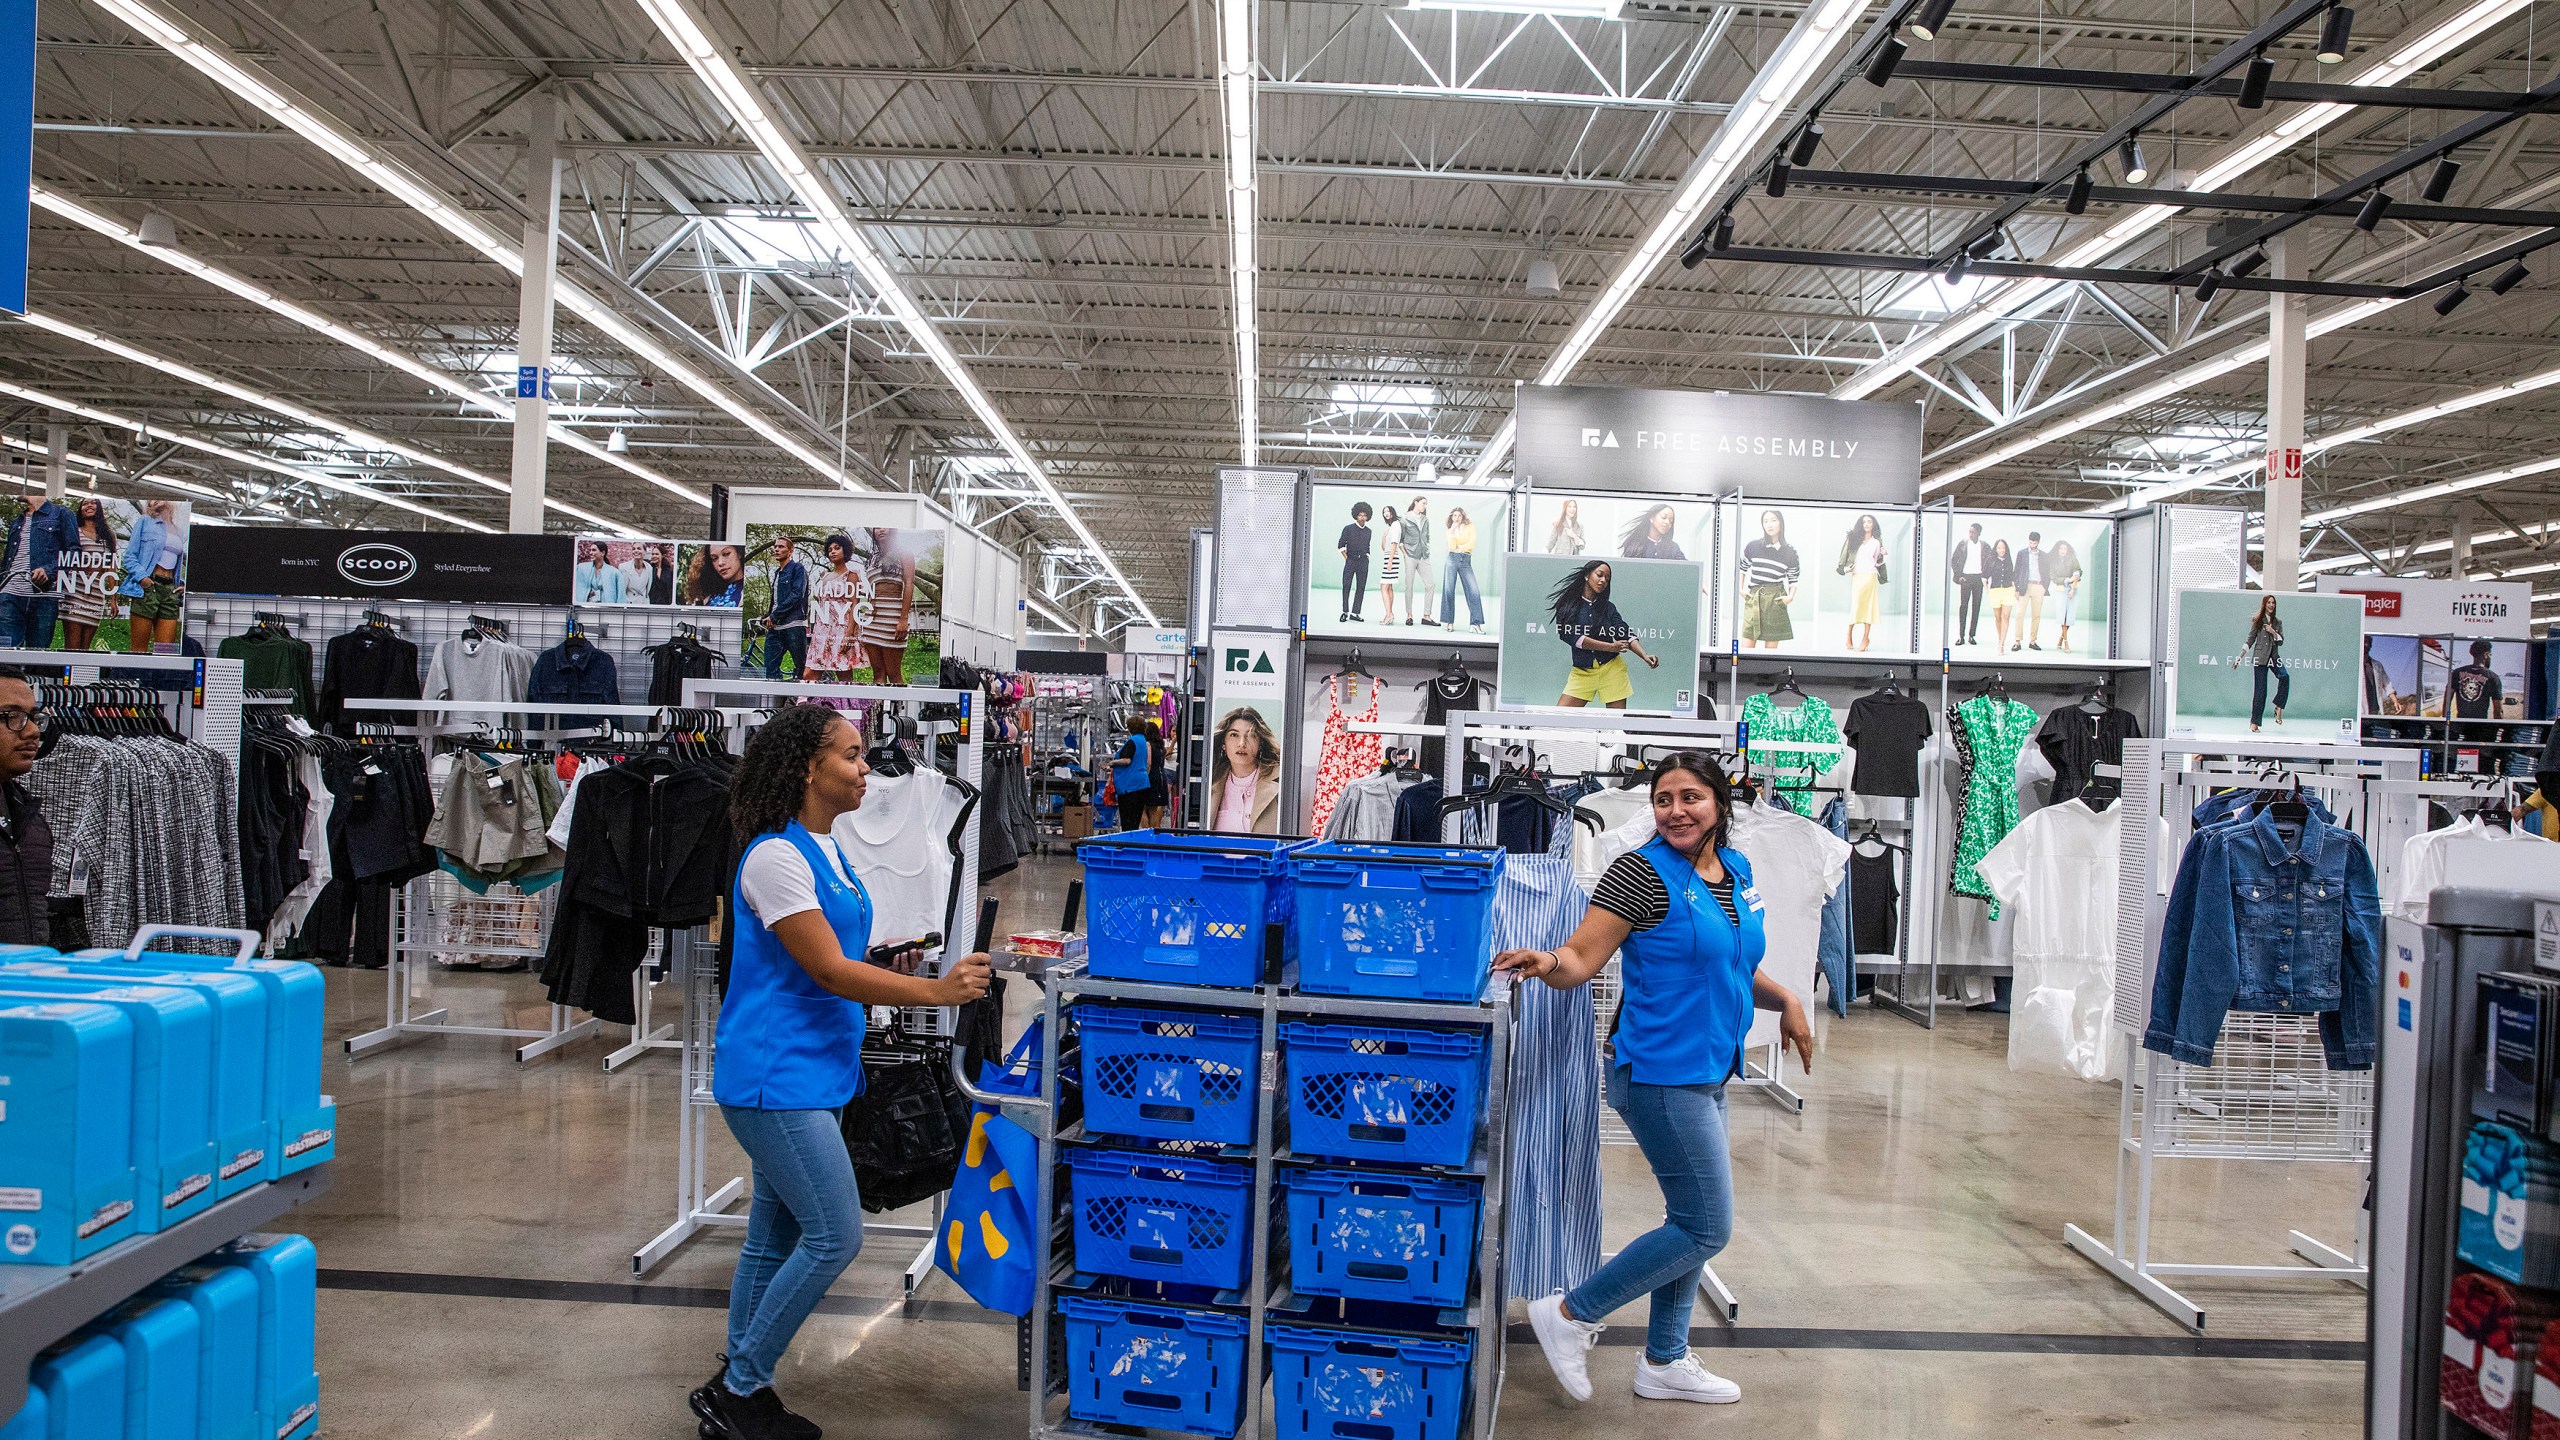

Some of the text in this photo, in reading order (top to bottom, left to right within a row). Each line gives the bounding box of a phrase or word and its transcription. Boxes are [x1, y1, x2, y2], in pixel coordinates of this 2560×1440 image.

[1636, 430, 1702, 450] FREE
[1716, 435, 1859, 459] ASSEMBLY
[57, 550, 122, 569] MADDEN
[345, 558, 409, 570] SCOOP
[434, 563, 492, 573] Styled Everywhere
[56, 570, 120, 596] NYC
[811, 580, 876, 600] MADDEN
[810, 601, 875, 627] NYC
[2452, 602, 2507, 617] FIVE STAR
[1555, 623, 1592, 636] FREE
[1598, 626, 1675, 640] ASSEMBLY
[2226, 655, 2260, 668] FREE
[2267, 656, 2340, 670] ASSEMBLY
[2397, 944, 2413, 963] VISA
[284, 1129, 332, 1157] FEASTABLES
[220, 1149, 265, 1179] FEASTABLES
